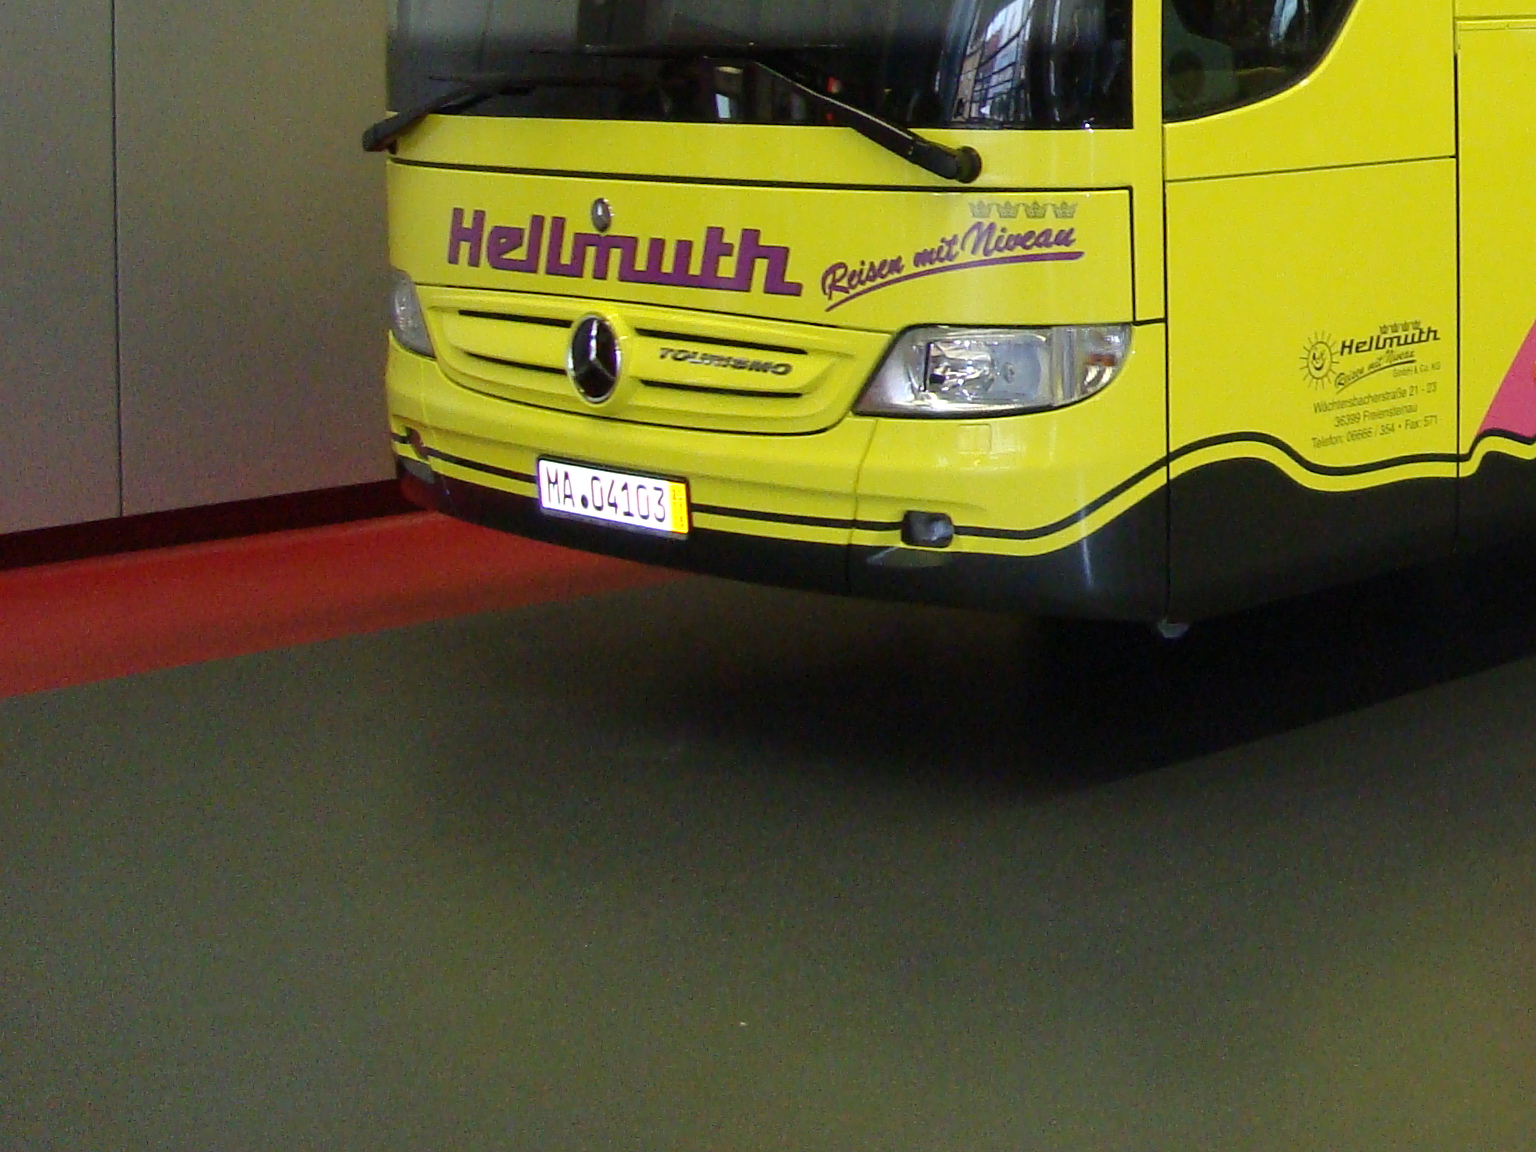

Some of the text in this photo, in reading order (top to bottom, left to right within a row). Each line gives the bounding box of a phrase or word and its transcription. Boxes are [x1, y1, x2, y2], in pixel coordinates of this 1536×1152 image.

[447, 207, 803, 297] Hellmuth
[821, 221, 1077, 300] Reisen mit Niveau
[1340, 326, 1440, 356] Hellmuth
[659, 347, 793, 376] TOURISMO
[1431, 362, 1441, 370] KG
[1409, 385, 1418, 396] 21
[546, 466, 575, 508] MA
[590, 475, 667, 524] 04103
